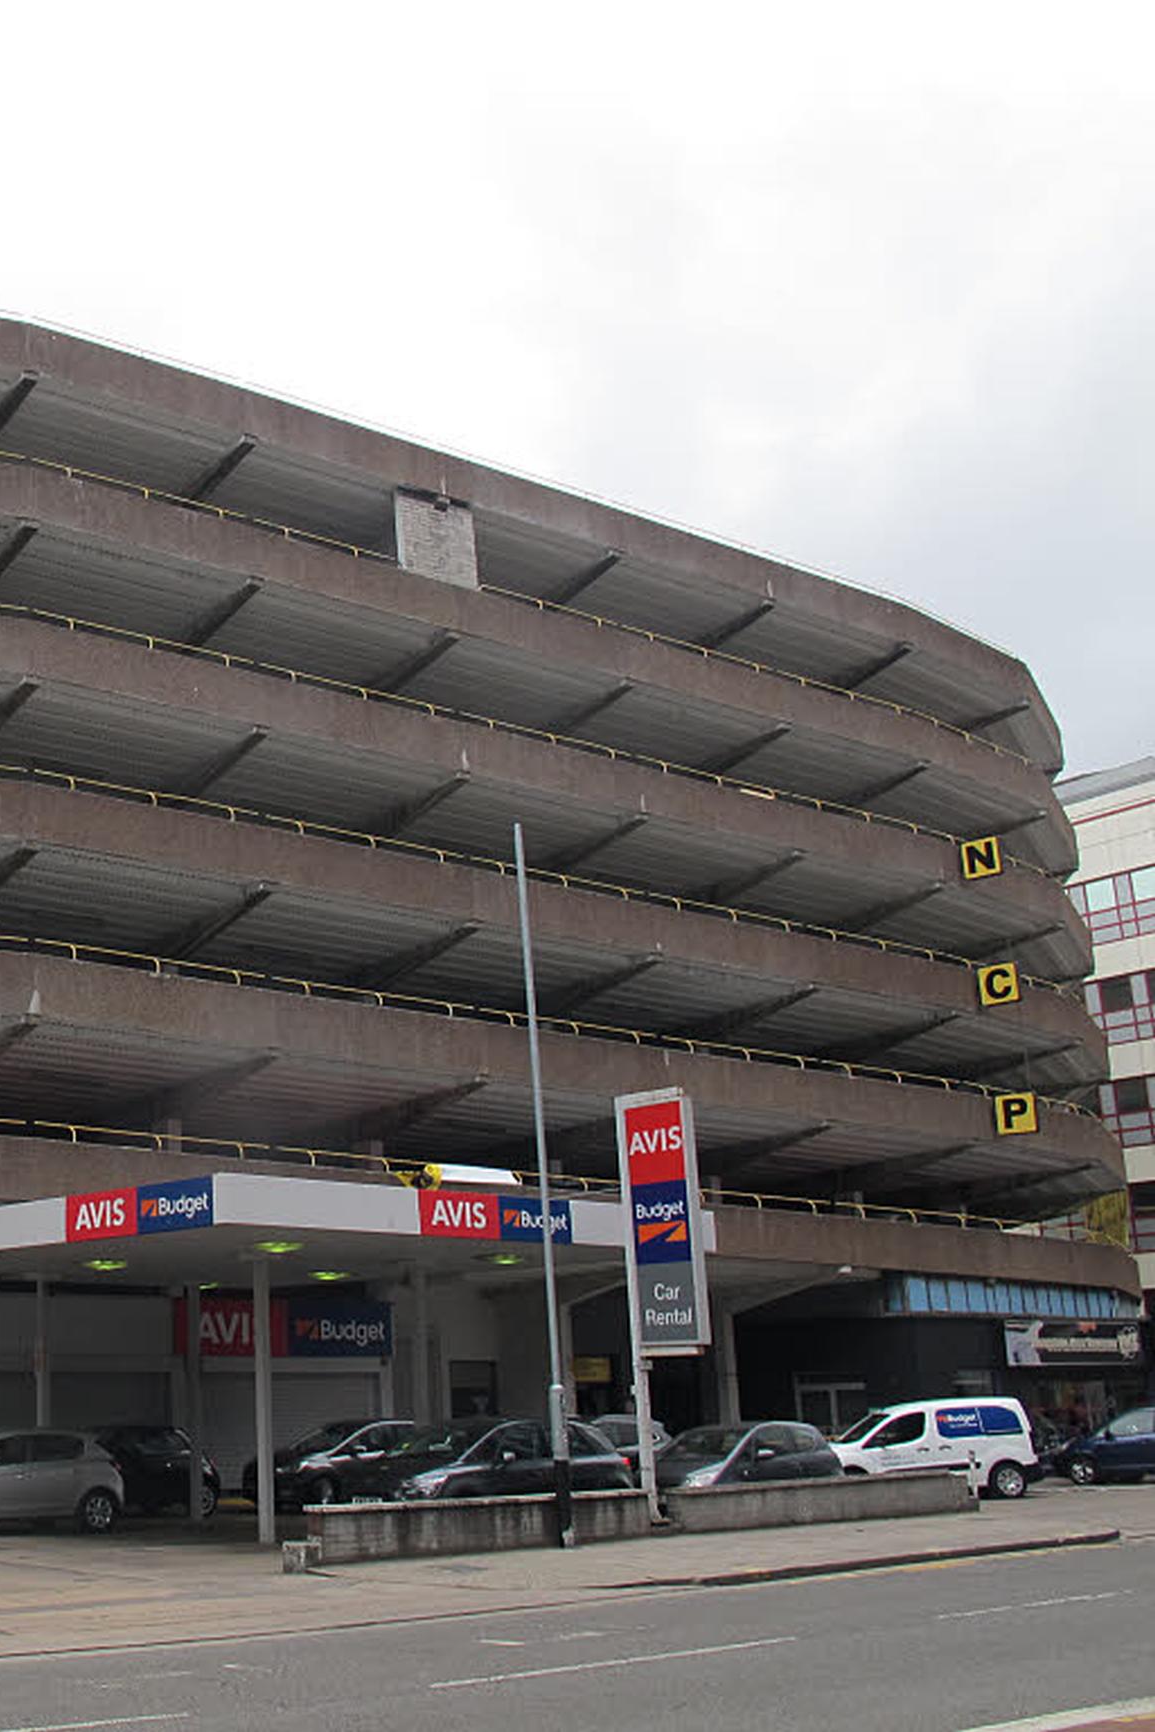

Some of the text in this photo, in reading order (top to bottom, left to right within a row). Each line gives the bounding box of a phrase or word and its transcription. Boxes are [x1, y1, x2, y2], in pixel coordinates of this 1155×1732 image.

[965, 841, 995, 873] N
[985, 968, 1012, 999] C
[1002, 1097, 1028, 1128] P
[629, 1125, 682, 1156] AVIS
[75, 1192, 209, 1230] AVIS Budget
[431, 1200, 487, 1229] AVIS
[636, 1200, 684, 1221] Budget
[654, 1282, 680, 1301] Car
[199, 1312, 386, 1347] AVI Budget
[645, 1307, 692, 1326] Rental
